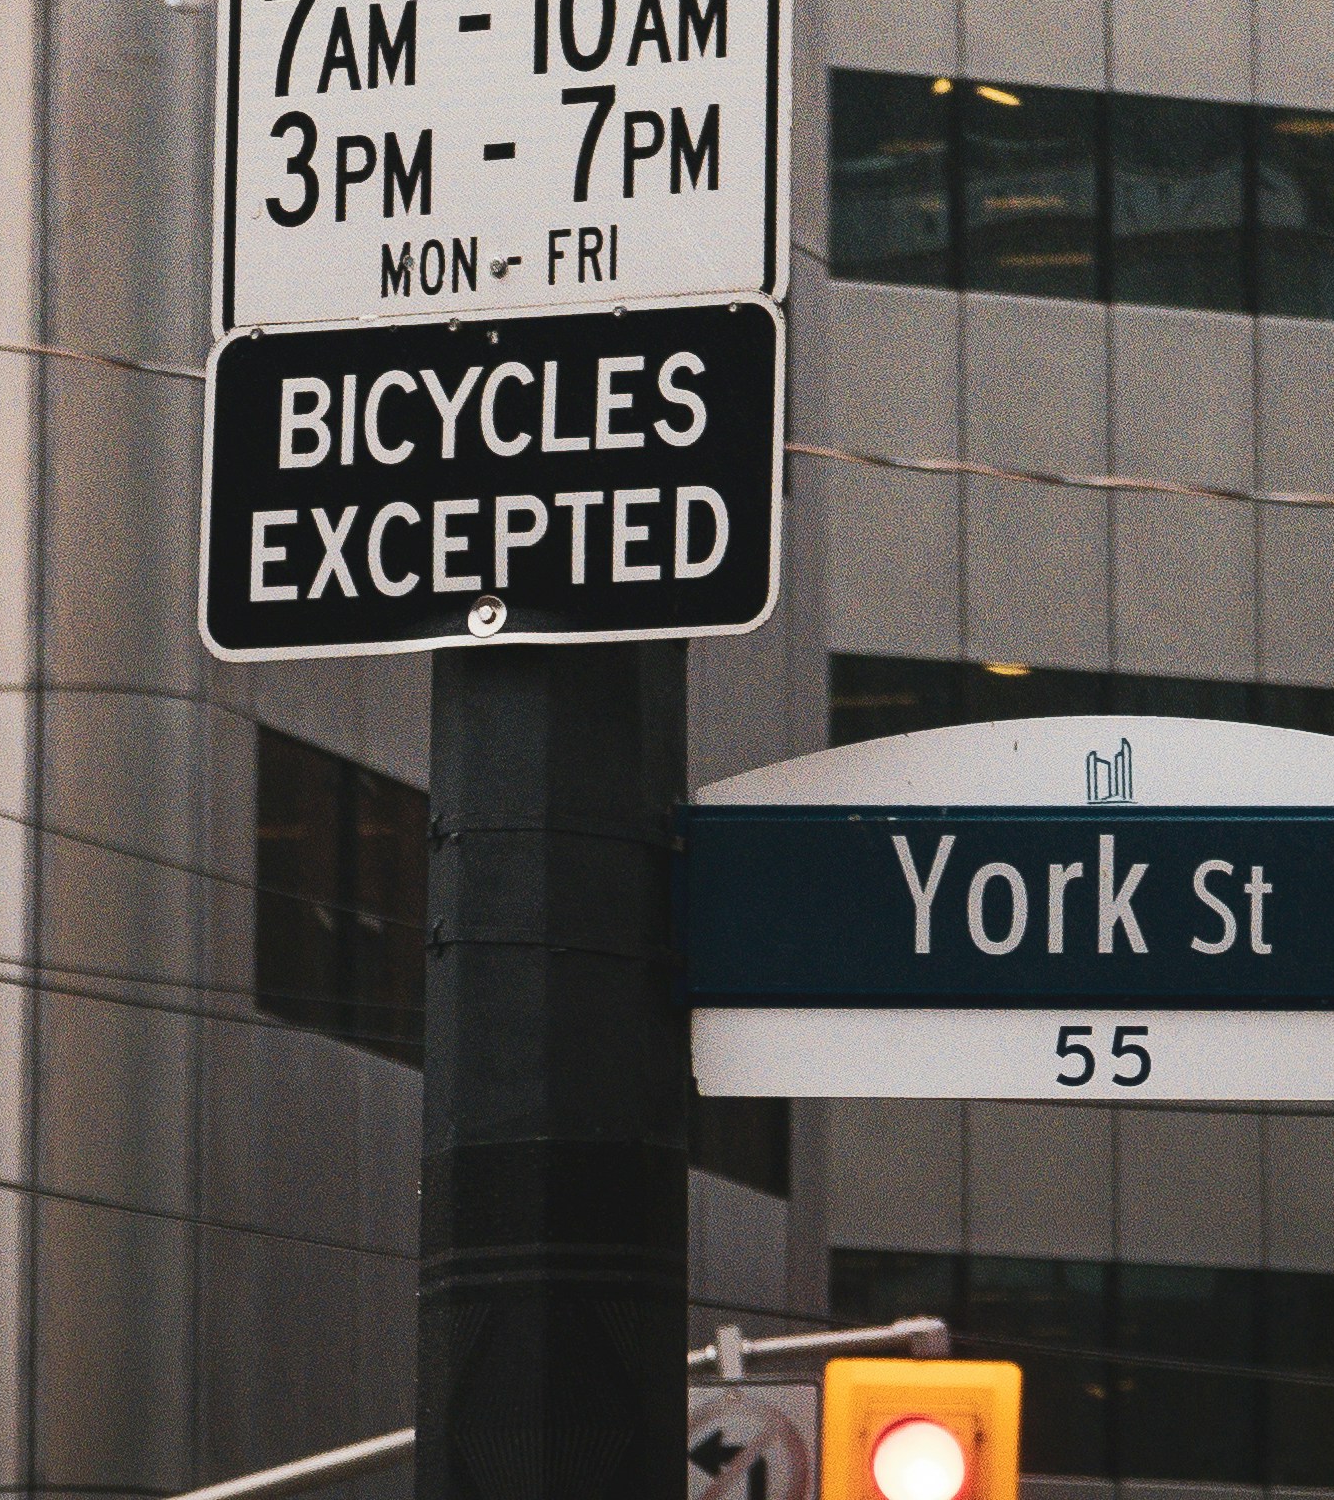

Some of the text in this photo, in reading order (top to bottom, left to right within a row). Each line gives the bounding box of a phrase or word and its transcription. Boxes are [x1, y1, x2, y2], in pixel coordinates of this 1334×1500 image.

[264, 109, 434, 229] 3PM
[560, 83, 721, 204] 7PM
[379, 235, 479, 299] MON
[546, 223, 619, 287] FRI
[277, 349, 709, 471] BICYCLES
[248, 483, 731, 604] EXCEPTED
[890, 833, 1274, 957] York St
[1054, 1024, 1153, 1088] 55
